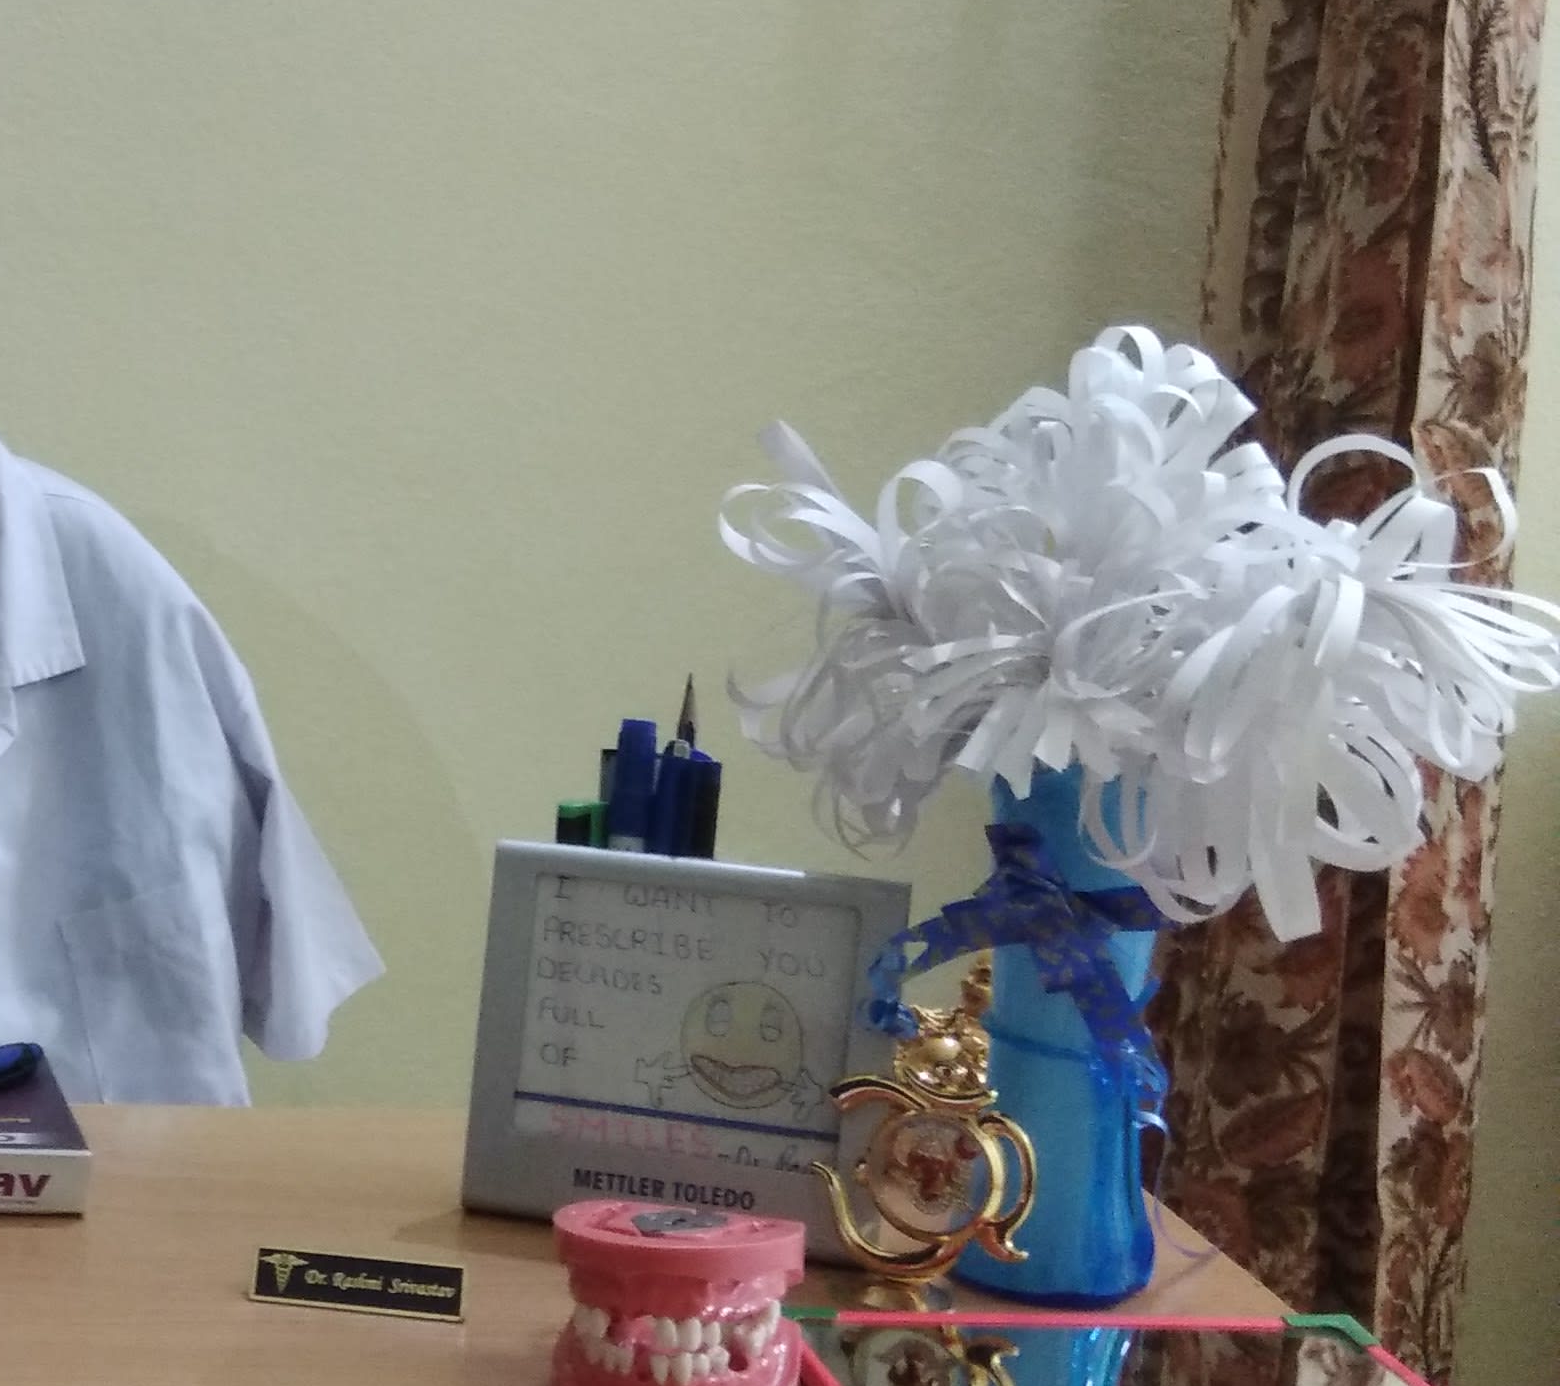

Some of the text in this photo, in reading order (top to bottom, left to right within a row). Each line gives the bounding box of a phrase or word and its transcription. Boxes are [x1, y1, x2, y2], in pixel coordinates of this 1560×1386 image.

[554, 875, 799, 929] I WANT TO
[543, 915, 826, 978] PRESCRIBE YOU
[537, 955, 663, 996] DECADES
[537, 995, 605, 1029] FULL
[539, 1041, 578, 1068] OF
[550, 1104, 716, 1160] SMILES
[573, 1168, 755, 1211] METTLER TOLEDO
